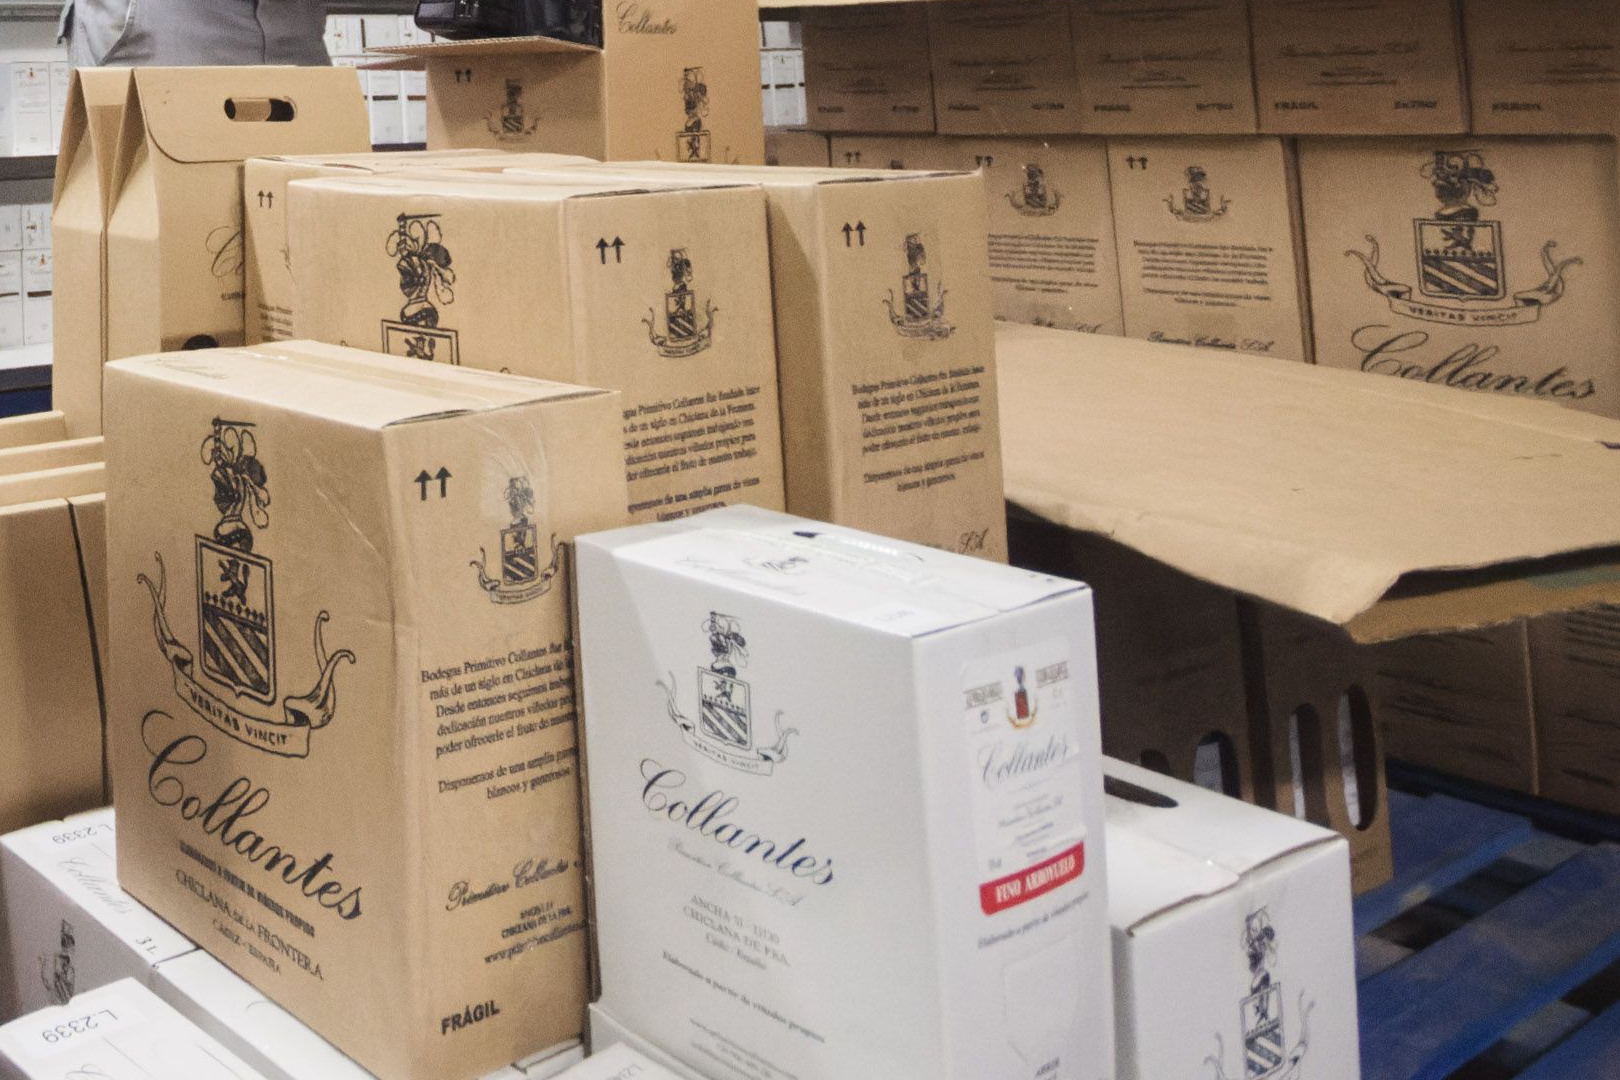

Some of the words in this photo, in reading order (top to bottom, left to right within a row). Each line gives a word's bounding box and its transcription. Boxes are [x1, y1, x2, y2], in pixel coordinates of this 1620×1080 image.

[1350, 324, 1596, 400] Collantes
[141, 708, 364, 921] Collantes
[640, 758, 835, 885] Collantes
[441, 999, 502, 1036] FRÁGIL
